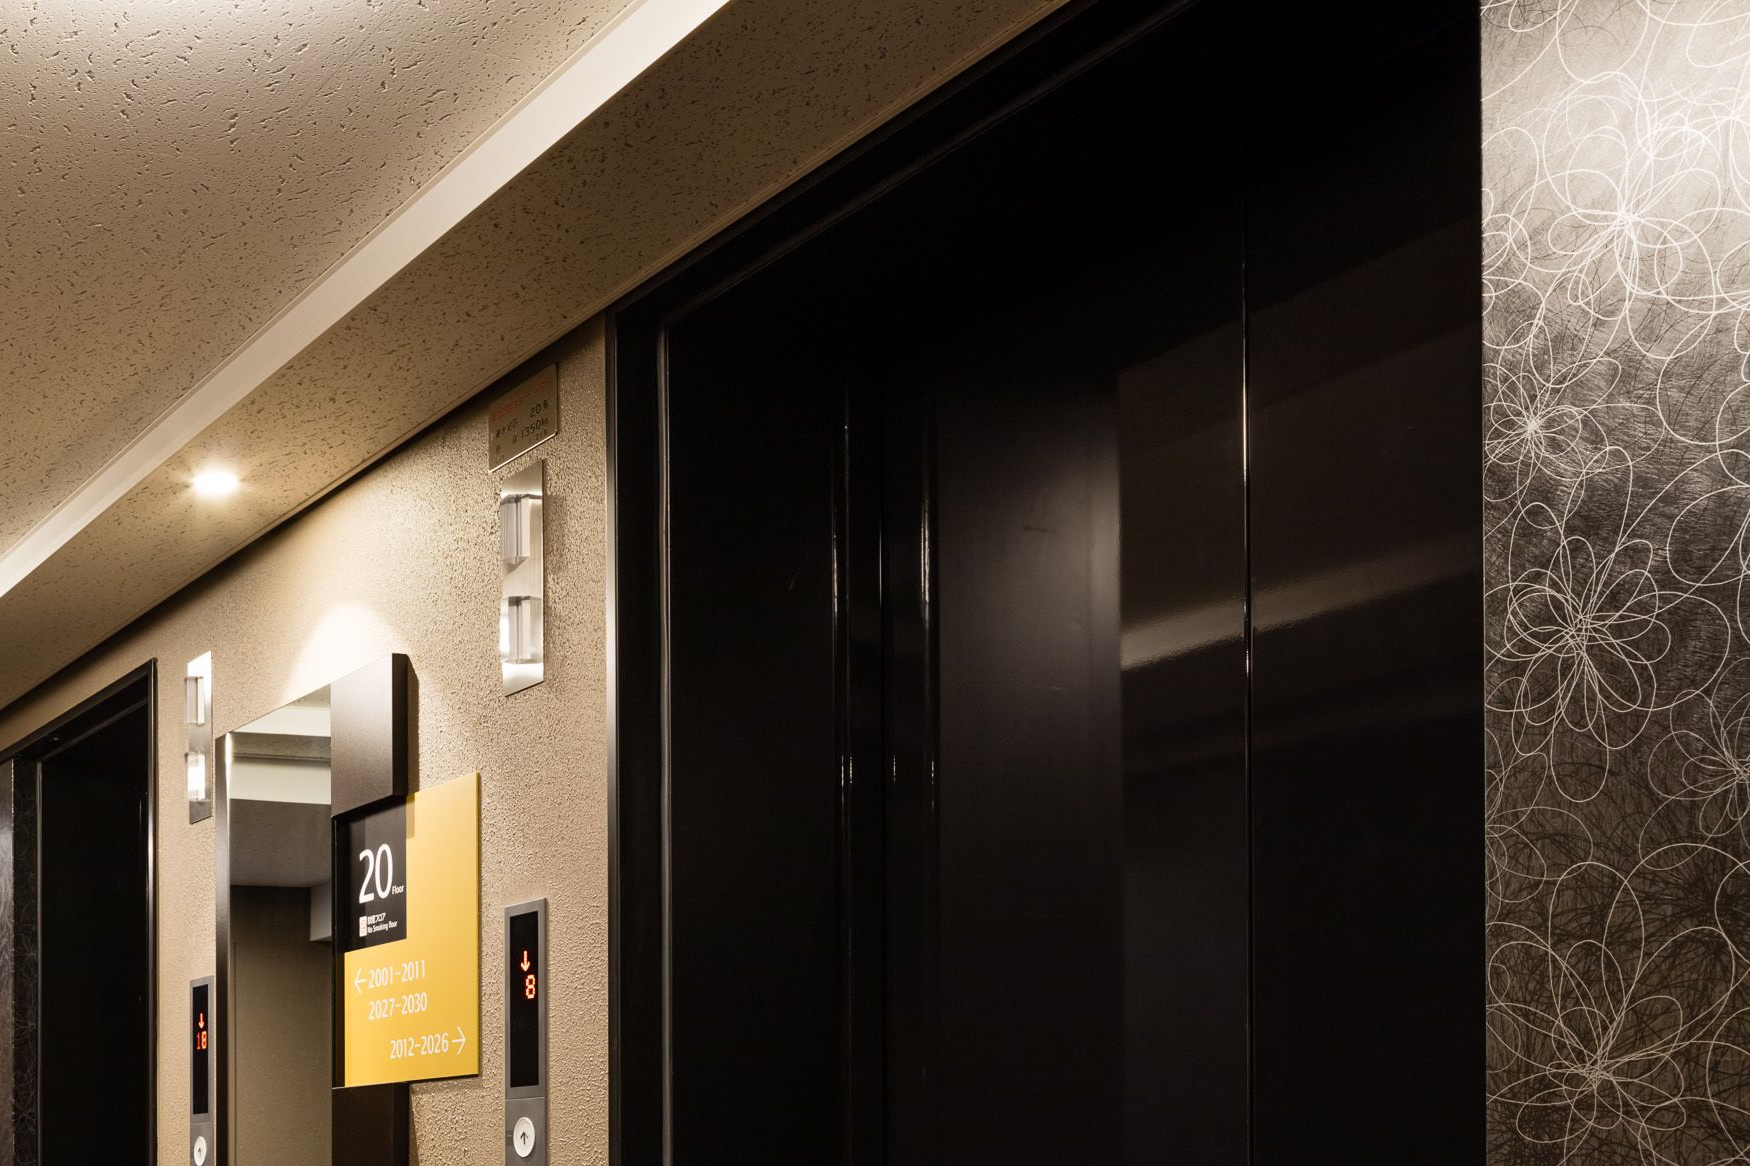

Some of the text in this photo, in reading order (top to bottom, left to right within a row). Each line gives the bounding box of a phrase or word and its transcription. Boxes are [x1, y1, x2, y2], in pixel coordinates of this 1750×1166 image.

[358, 843, 405, 904] 20 Floor
[368, 959, 426, 989] 2001-2011
[525, 974, 536, 999] 8
[368, 992, 428, 1020] 2027-2030
[196, 1030, 207, 1050] 18
[390, 1032, 449, 1060] 2012-2026
